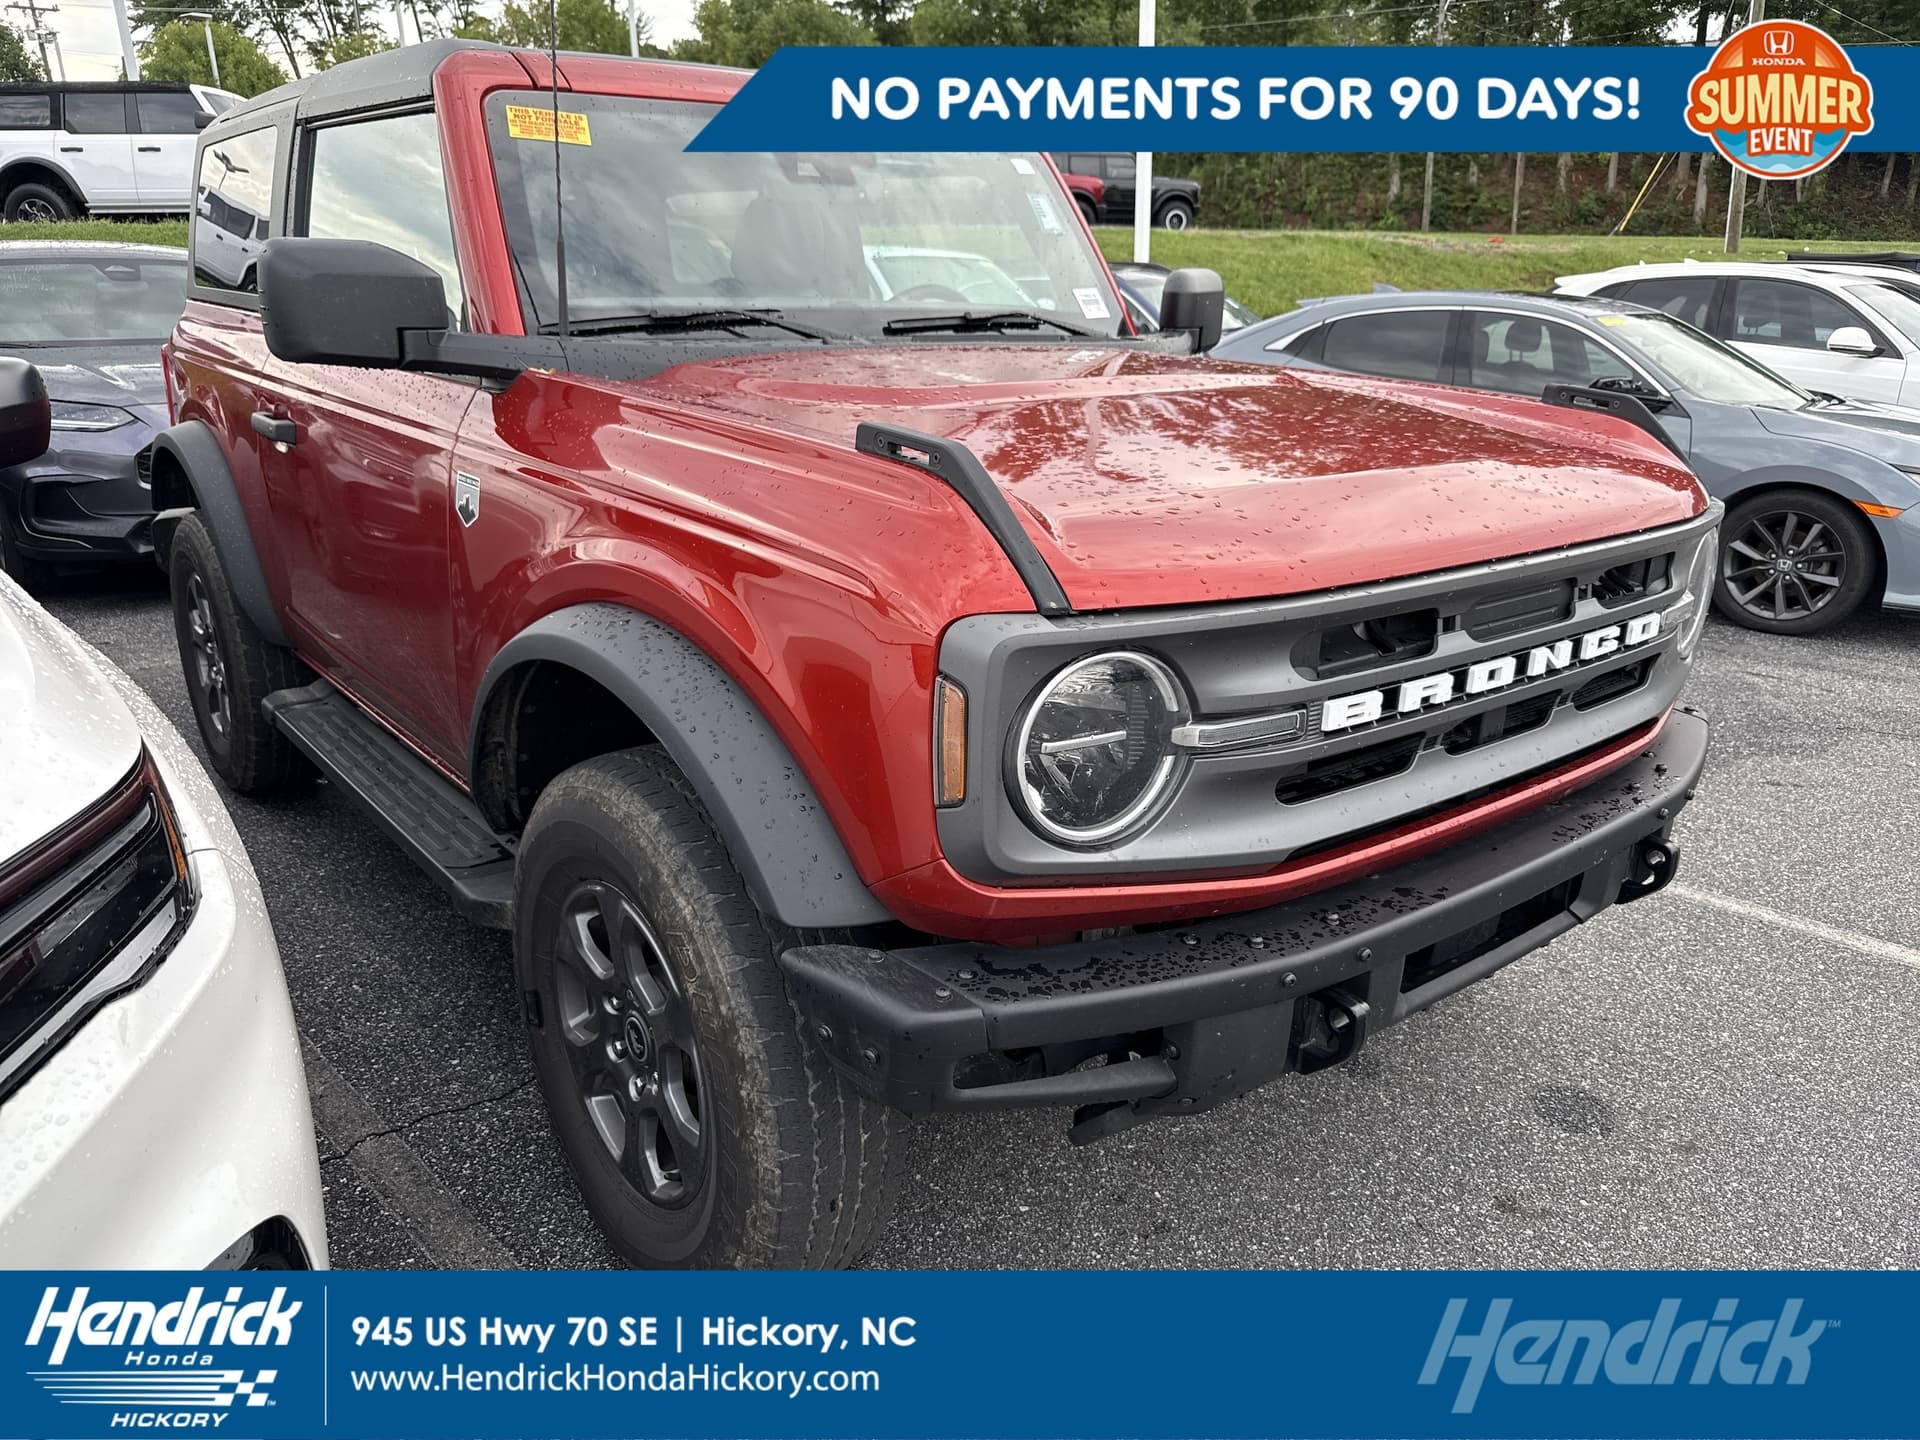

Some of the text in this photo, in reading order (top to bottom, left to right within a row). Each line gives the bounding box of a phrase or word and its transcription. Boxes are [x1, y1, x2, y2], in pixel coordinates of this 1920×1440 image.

[509, 107, 530, 115] THIS
[532, 110, 572, 120] VEHILE
[513, 113, 532, 121] NOT
[1320, 612, 1661, 733] BRONCO
